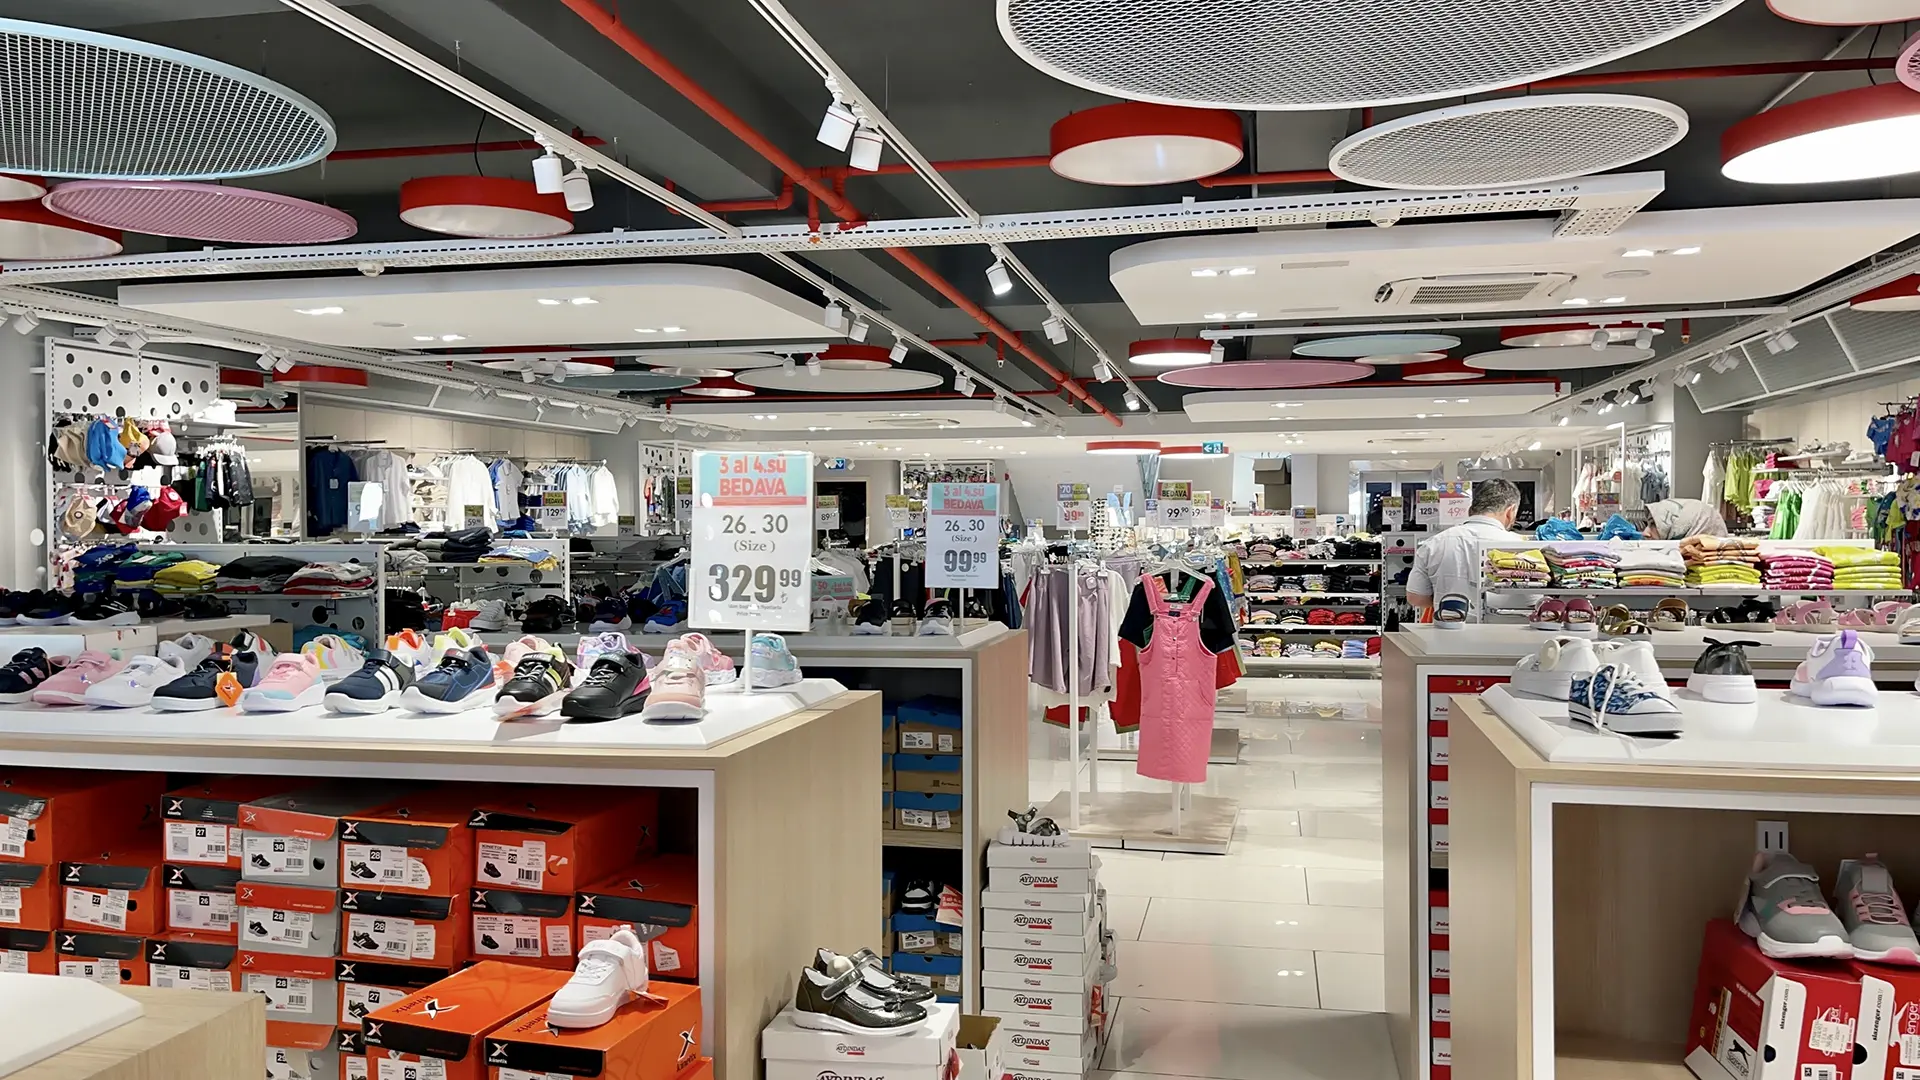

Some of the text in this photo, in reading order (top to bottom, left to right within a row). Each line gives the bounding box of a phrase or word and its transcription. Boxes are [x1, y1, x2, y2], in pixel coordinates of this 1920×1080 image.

[720, 456, 729, 475] 3
[733, 455, 748, 474] al
[720, 478, 787, 496] BEDAVA
[944, 485, 950, 497] 3
[952, 484, 962, 497] al
[1162, 489, 1187, 498] BEDAVA
[943, 498, 985, 510] BEDAVA
[546, 508, 560, 517] 129
[1167, 508, 1180, 518] 99
[722, 514, 747, 534] 26
[762, 514, 789, 534] 30
[944, 519, 960, 532] 26
[968, 519, 985, 532] 30
[951, 534, 972, 543] (Size
[734, 540, 767, 553] (Size
[944, 549, 973, 573] 99
[973, 552, 987, 564] 99
[708, 564, 776, 603] 329
[780, 569, 802, 588] 99
[274, 843, 284, 851] 30
[370, 851, 381, 860] 28
[200, 897, 209, 905] 26
[273, 912, 284, 921] 28
[375, 922, 385, 931] 28
[276, 980, 287, 988] 28
[369, 992, 379, 1001] 27
[1906, 1001, 1920, 1035] enger
[405, 1069, 416, 1079] 29
